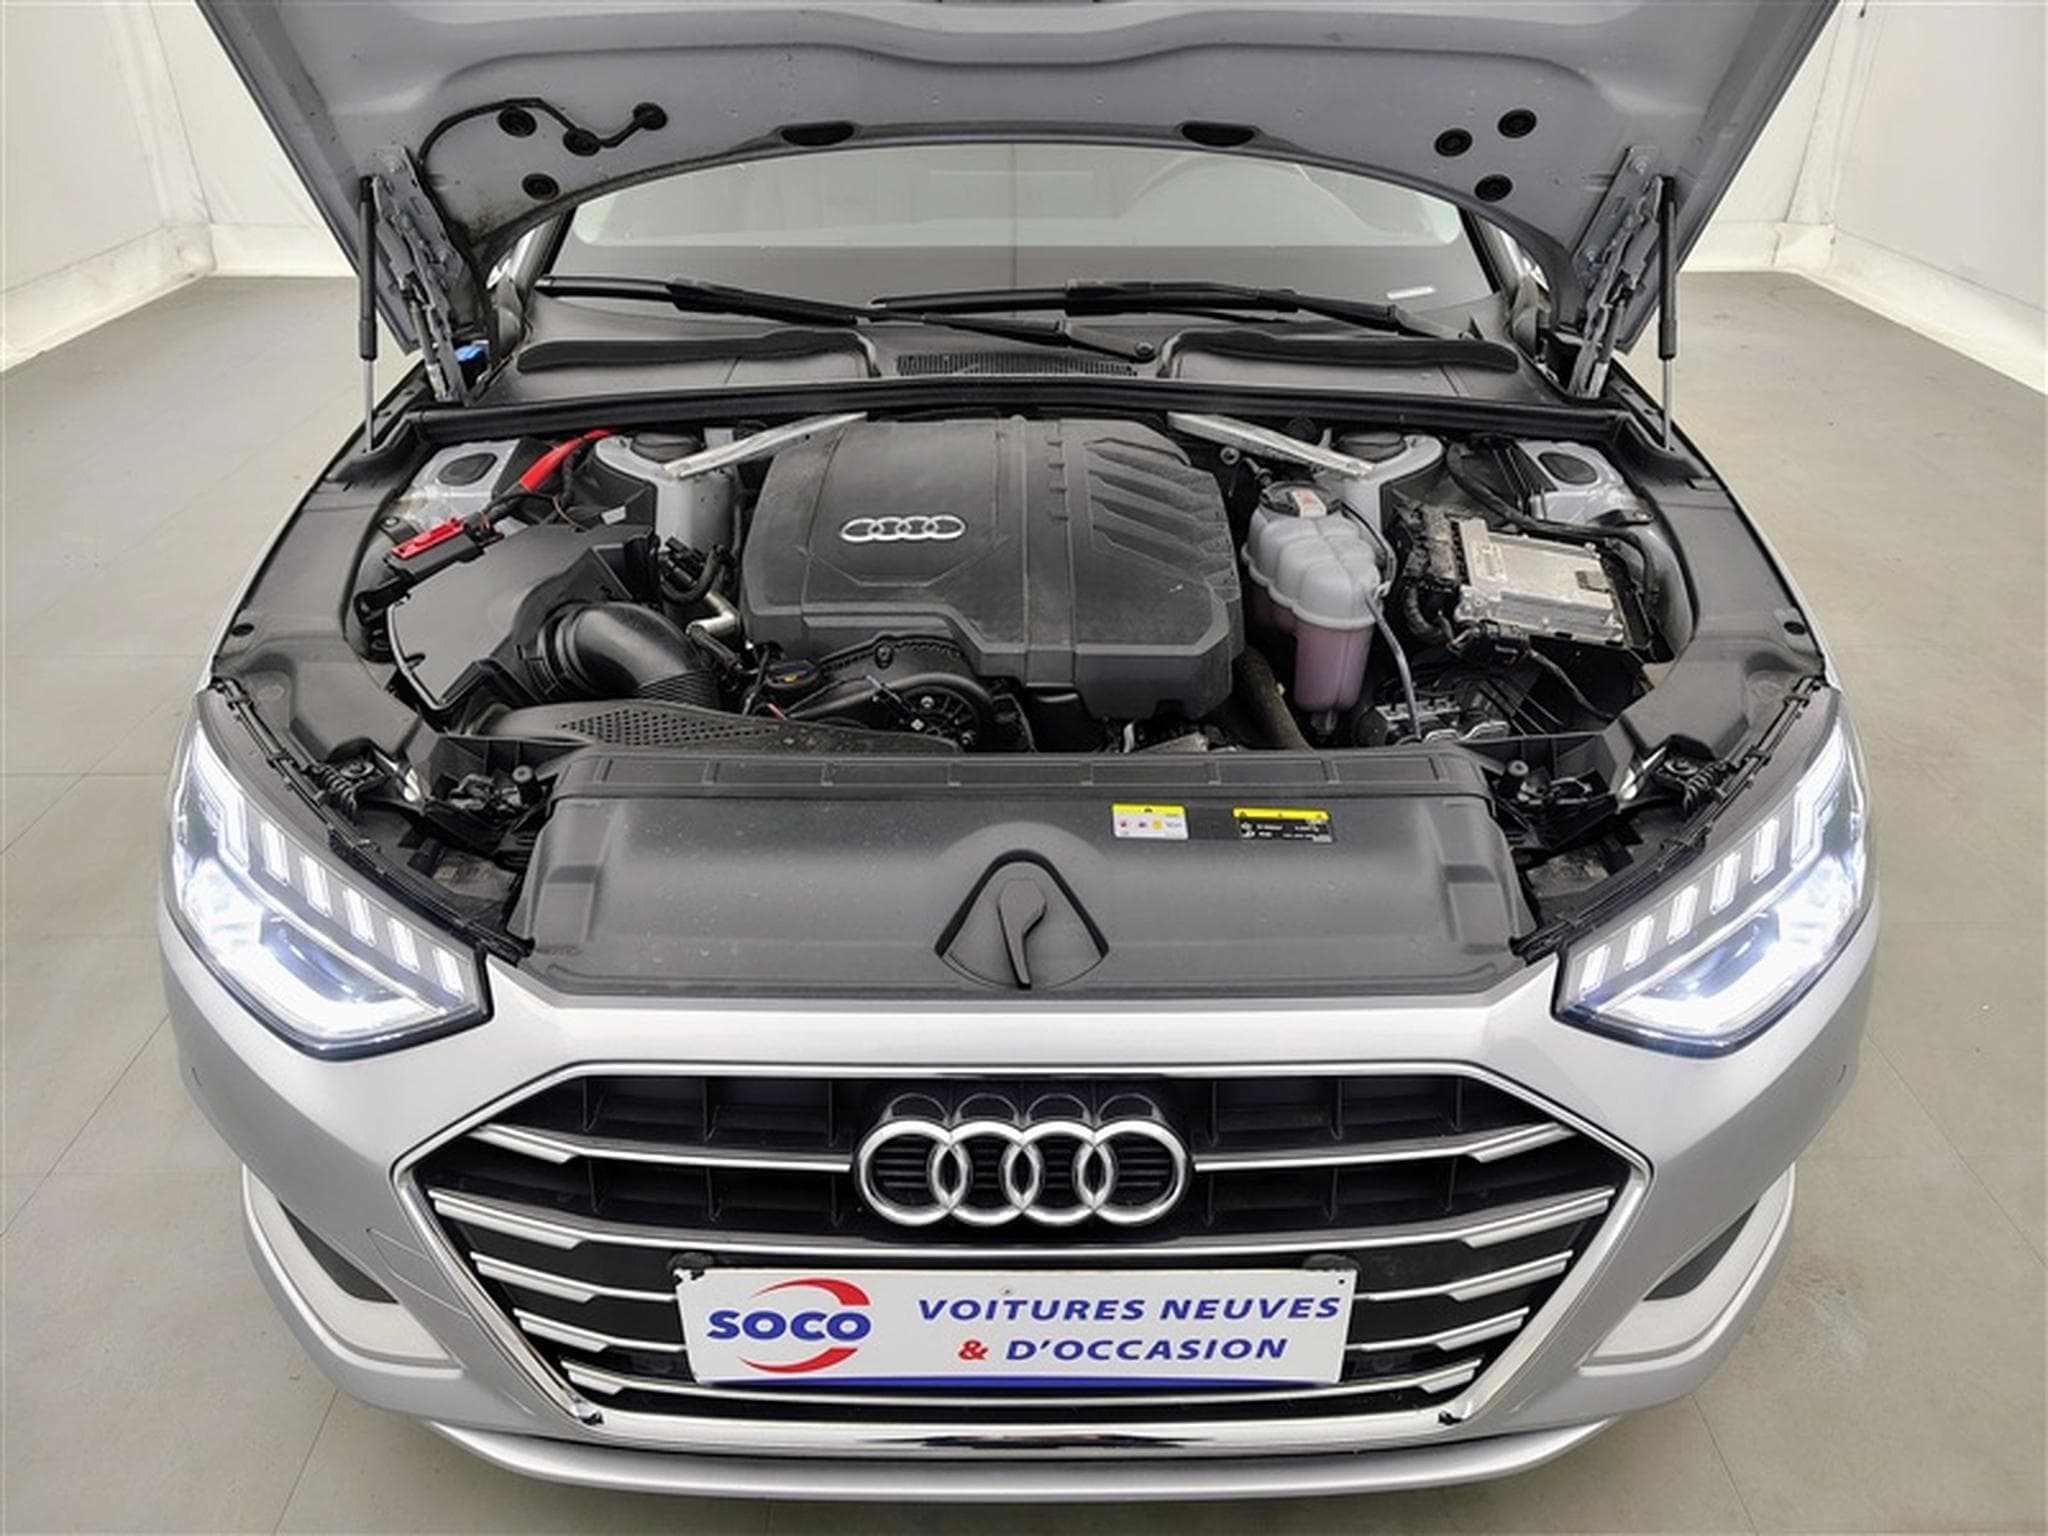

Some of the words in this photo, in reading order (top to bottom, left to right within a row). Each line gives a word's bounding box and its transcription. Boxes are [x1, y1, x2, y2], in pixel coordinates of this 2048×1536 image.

[918, 1298, 1145, 1322] VOITURES
[1159, 1296, 1339, 1322] NEUVES
[706, 1308, 872, 1342] SOCO
[957, 1339, 988, 1363] &
[1006, 1336, 1287, 1362] D'OCCASION
